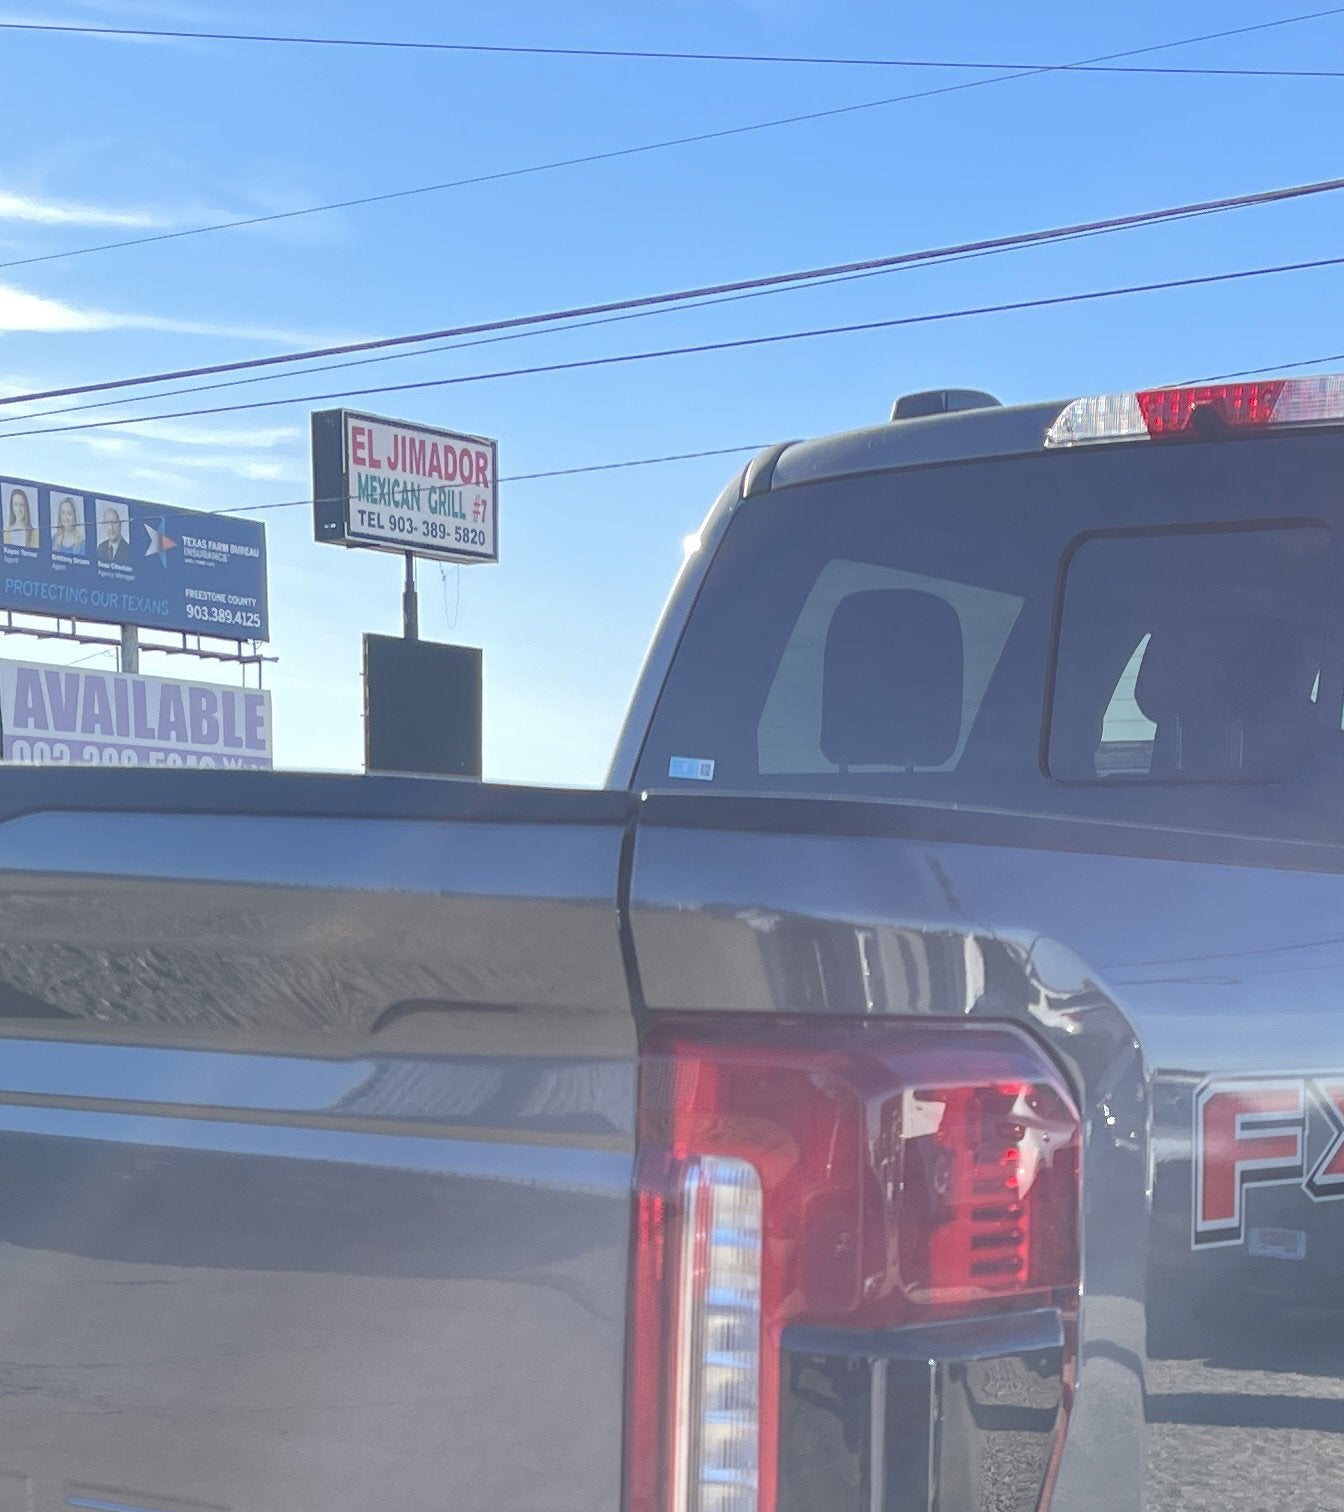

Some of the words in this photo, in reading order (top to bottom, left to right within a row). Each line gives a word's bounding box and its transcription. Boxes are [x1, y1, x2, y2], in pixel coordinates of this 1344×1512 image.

[351, 426, 382, 469] EL
[386, 433, 489, 489] JIMADOR
[357, 472, 421, 512] MEXICAN
[428, 486, 467, 520] GRILL
[472, 494, 488, 524] #7
[357, 509, 385, 530] TEL
[454, 526, 487, 546] 5820
[181, 536, 208, 550] TEXAS
[208, 540, 230, 553] FARM
[230, 544, 260, 558] BUREAU
[4, 578, 88, 604] PROTECTING
[90, 590, 118, 608] OUR
[121, 594, 169, 616] TEXANS
[184, 588, 227, 604] FREESTONE
[227, 594, 257, 607] COUNTY
[185, 603, 261, 628] 903.389.4125
[13, 667, 267, 751] AVAILABLE
